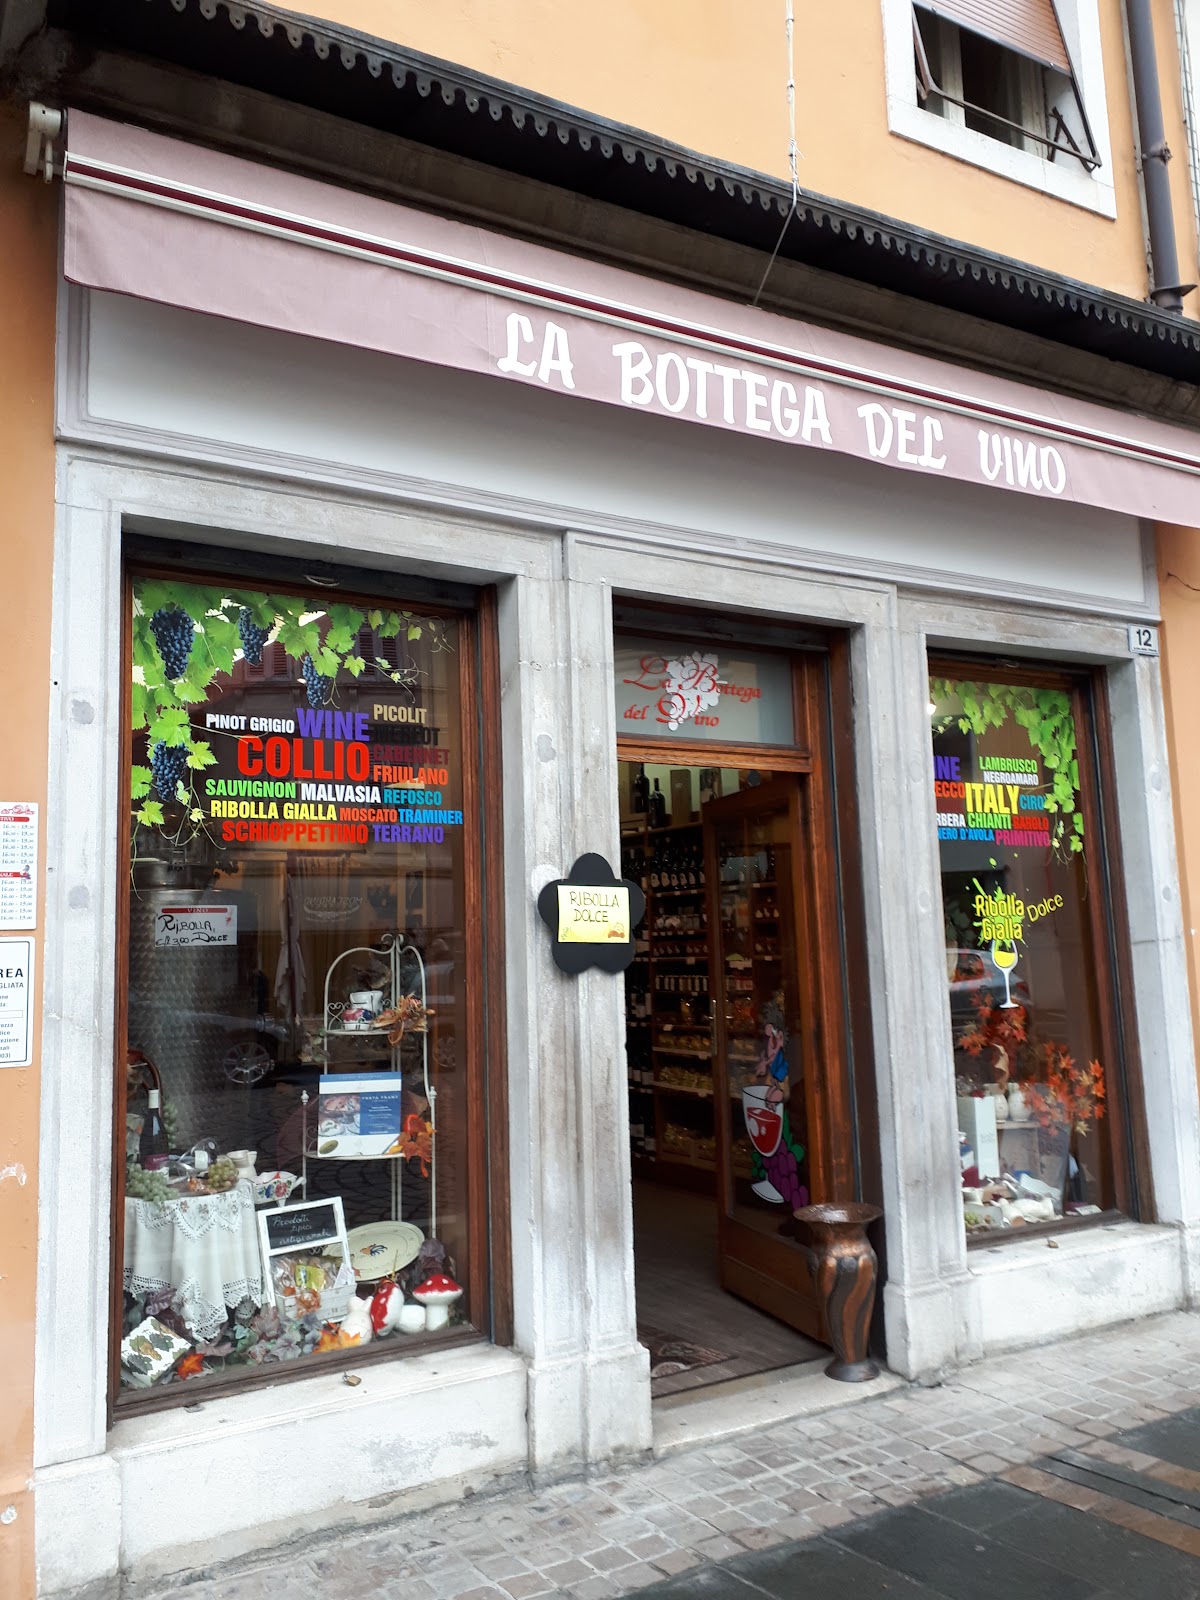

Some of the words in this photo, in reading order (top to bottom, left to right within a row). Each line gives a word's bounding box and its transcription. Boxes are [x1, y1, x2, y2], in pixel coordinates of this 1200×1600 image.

[497, 312, 575, 390] LA
[612, 341, 832, 444] BOTTEGA
[857, 403, 947, 470] DEL
[978, 428, 1066, 494] VINO
[1136, 629, 1152, 647] 12
[623, 655, 672, 691] La
[677, 657, 762, 703] Bottega
[373, 704, 427, 724] PICOLIT
[624, 704, 649, 720] del
[206, 713, 247, 732] PINOT
[250, 716, 295, 734] GRIGIO
[296, 707, 370, 741] WINE
[237, 735, 370, 782] COLLIO
[373, 743, 450, 765] CABERNET
[979, 756, 1038, 774] LAMBRUSCO
[373, 764, 449, 786] FRIULANO
[983, 770, 1039, 786] NEGROAMARO
[205, 778, 296, 799] SAUVIGNON
[301, 783, 381, 804] MALVASIA
[383, 788, 442, 806] REFOSCO
[934, 781, 965, 798] ECCO
[965, 782, 1020, 815] ITALY
[210, 800, 279, 820] RIBOLLA
[283, 802, 337, 822] GIALLA
[339, 807, 397, 823] MOSCATO
[398, 808, 463, 825] TRAMINER
[967, 812, 1012, 830] CHIANTI
[1013, 815, 1049, 831] BAROLO
[222, 821, 369, 844] SCHIOPPETTINO
[372, 824, 444, 844] TERRANO
[960, 828, 994, 842] D'AVOLA
[995, 830, 1051, 847] PRIMITIVO
[569, 891, 619, 908] RIBOLLA
[975, 894, 1025, 917] Ribolla
[1026, 894, 1064, 922] Dolce
[573, 908, 609, 923] DOLCE
[982, 918, 1023, 941] Gialla
